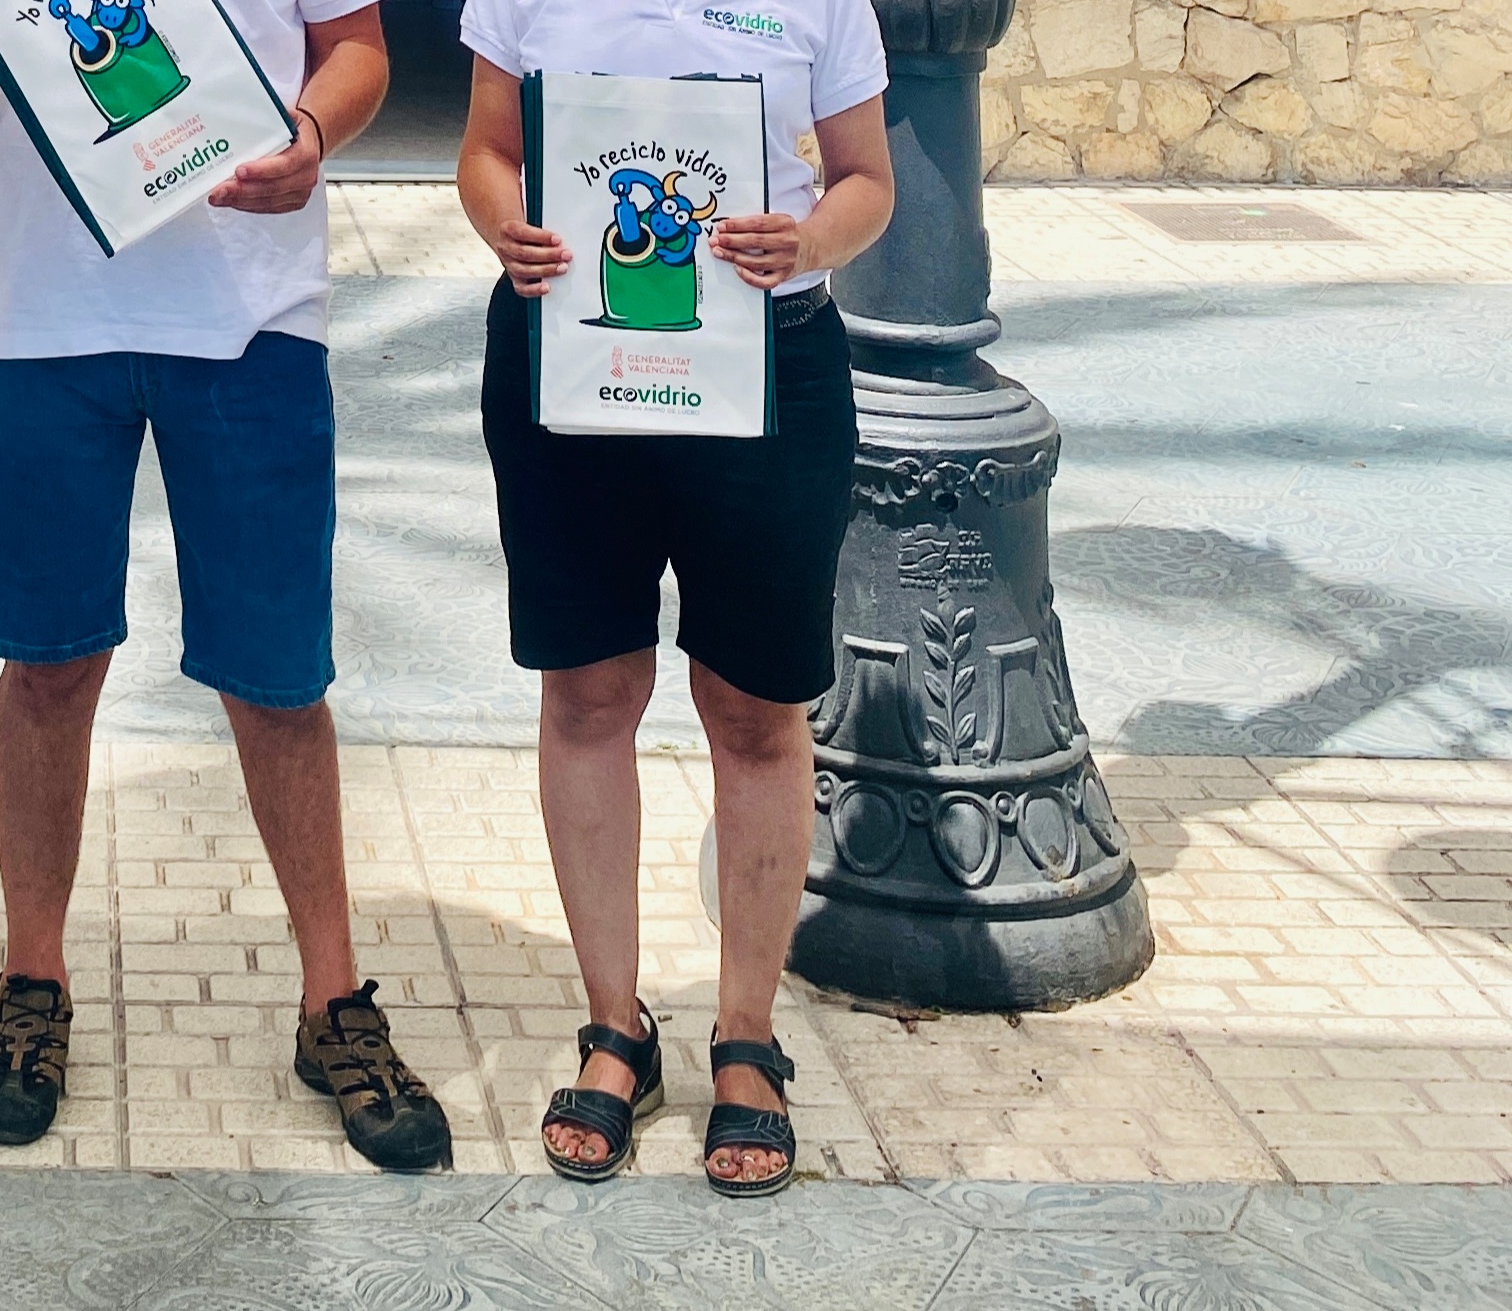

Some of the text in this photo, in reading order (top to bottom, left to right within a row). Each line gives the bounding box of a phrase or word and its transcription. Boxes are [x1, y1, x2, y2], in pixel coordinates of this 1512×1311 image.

[15, 6, 41, 27] Yo
[703, 8, 783, 33] ecovidrio
[148, 113, 201, 150] GENERALITAT
[153, 123, 206, 157] VALENCIANA
[143, 138, 230, 197] ecovidrio
[573, 161, 600, 187] Yo
[599, 140, 666, 170] reciclo
[627, 354, 691, 366] GENERALITAT
[628, 364, 690, 376] VALENCIANA
[599, 383, 702, 407] ecovidrio
